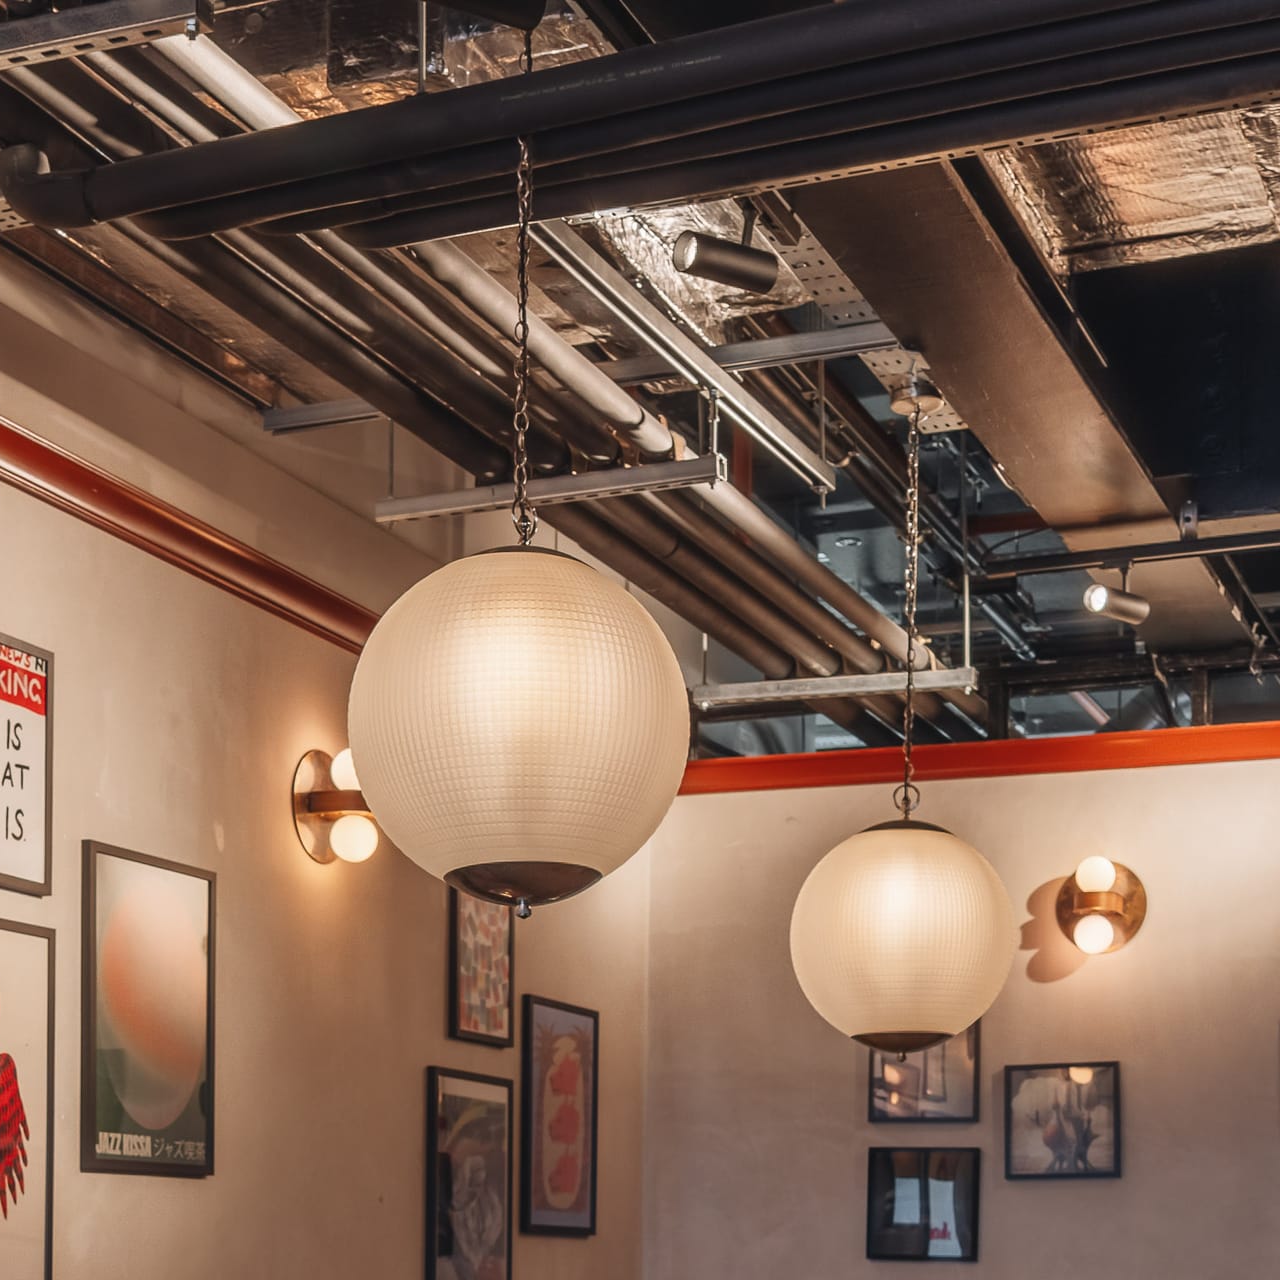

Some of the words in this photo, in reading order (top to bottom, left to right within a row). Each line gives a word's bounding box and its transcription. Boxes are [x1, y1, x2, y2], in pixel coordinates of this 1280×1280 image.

[0, 645, 31, 668] NEWS
[6, 719, 23, 751] IS
[95, 1131, 121, 1155] JAZZ
